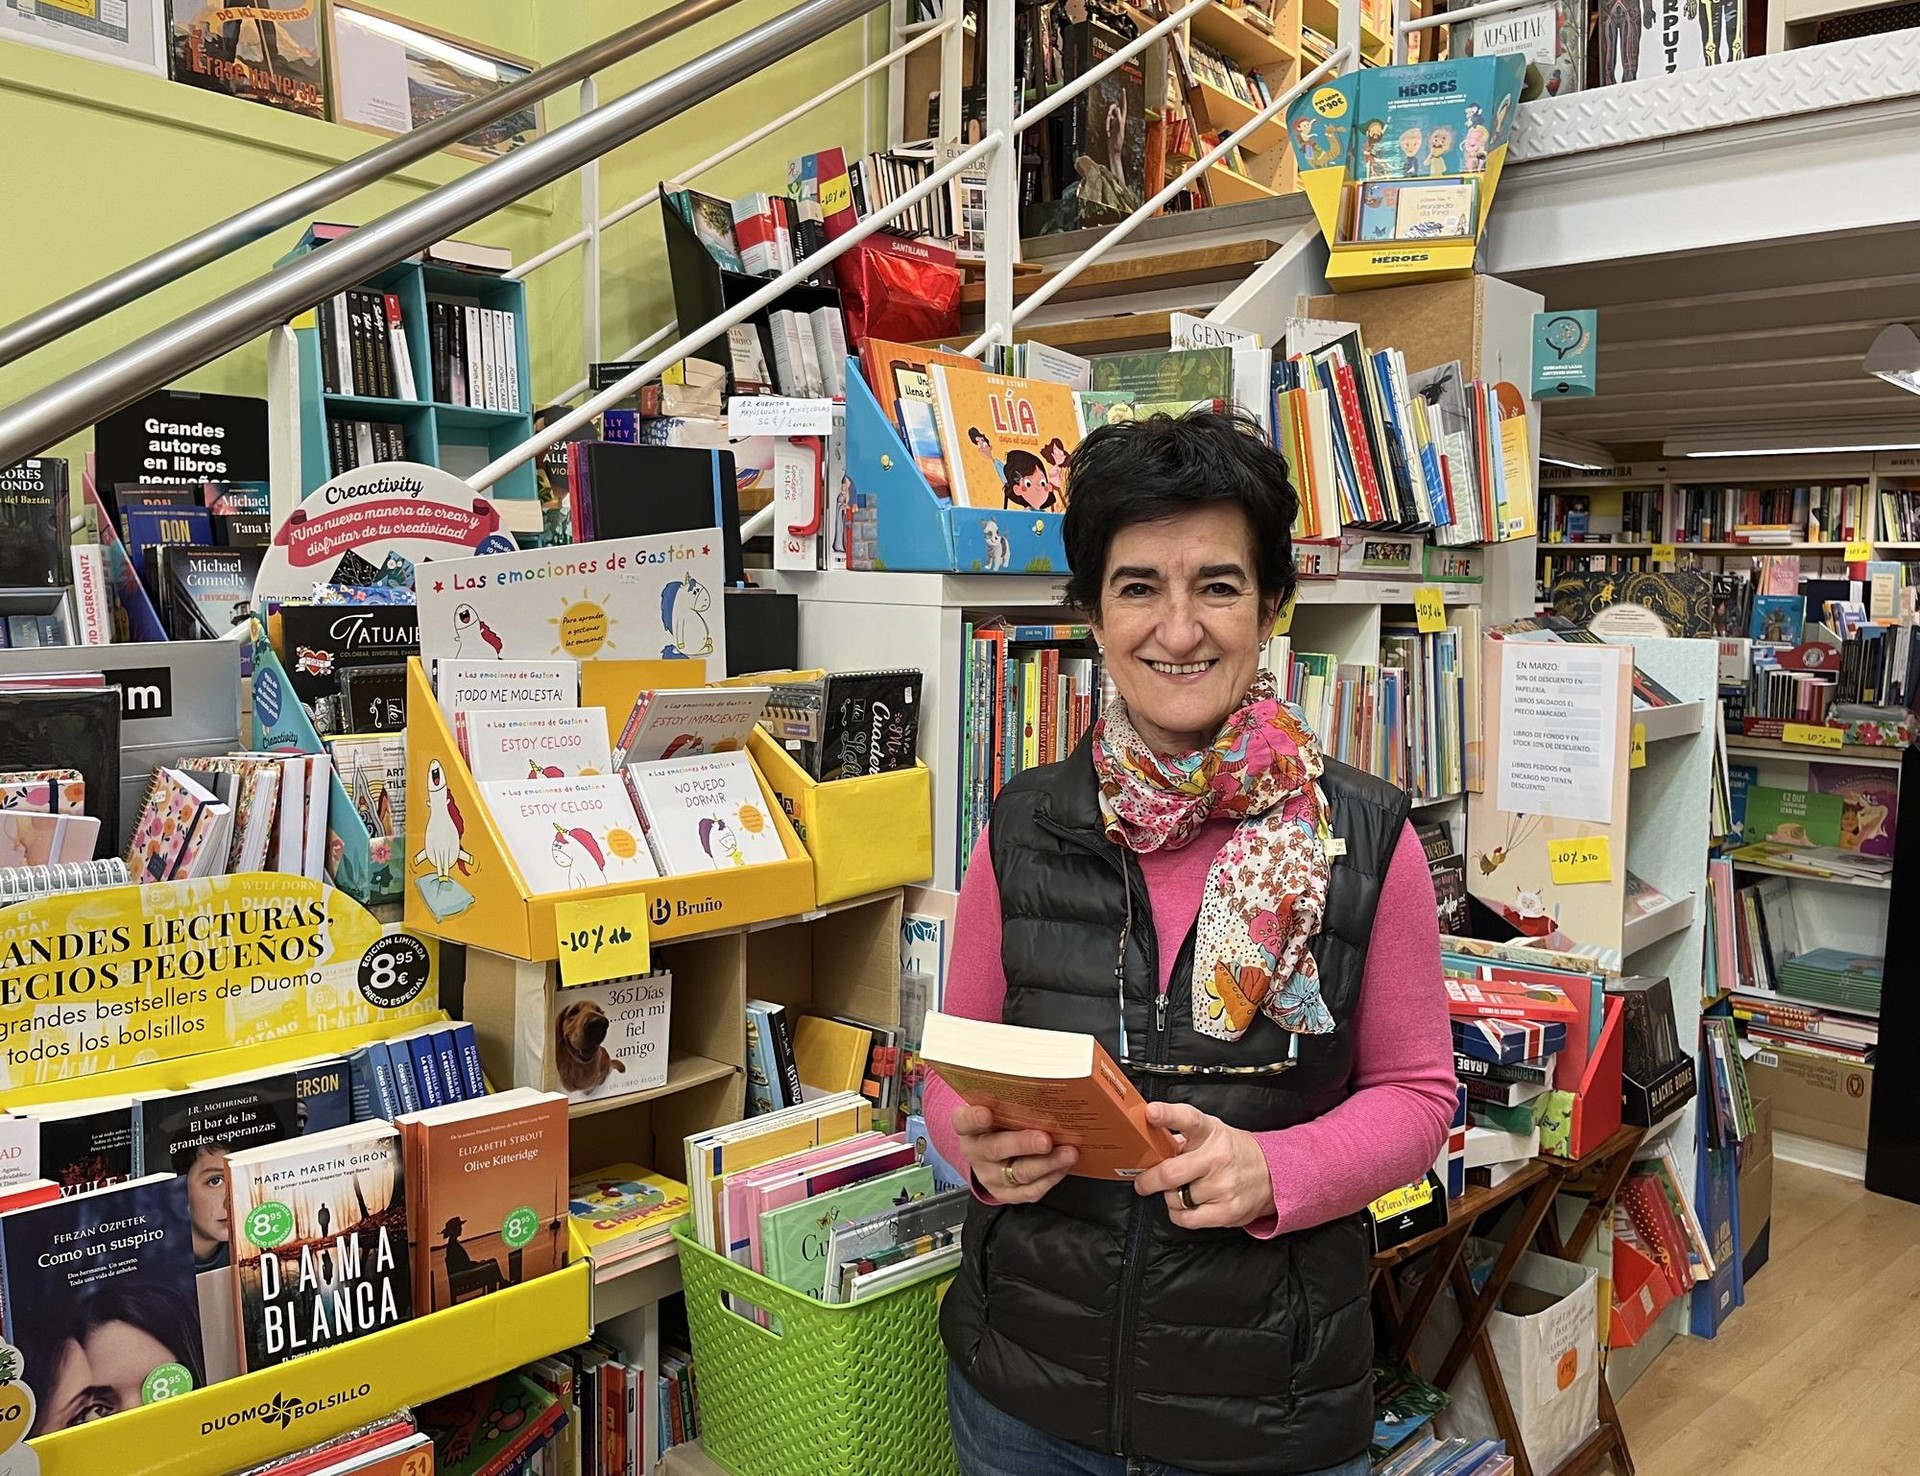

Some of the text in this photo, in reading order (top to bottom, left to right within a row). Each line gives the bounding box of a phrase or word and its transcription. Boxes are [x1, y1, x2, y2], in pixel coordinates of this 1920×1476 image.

[1399, 80, 1457, 98] HÉROES
[891, 241, 929, 258] SANTILLANA
[1371, 253, 1429, 265] HÉROES
[988, 388, 1040, 437] LÍA
[145, 418, 225, 438] Grandes
[149, 439, 221, 455] autores
[144, 456, 227, 473] en libros
[325, 476, 424, 505] Creactivity
[221, 495, 269, 507] Michael
[325, 513, 363, 531] nueva
[364, 505, 415, 521] manera
[416, 504, 433, 517] de
[434, 508, 468, 524] crear
[469, 515, 480, 530] y
[160, 519, 192, 543] DON
[307, 522, 467, 558] disfrutar de tu creatividad!
[189, 559, 242, 573] Michael
[453, 543, 696, 592] Las emociones de Gastón
[186, 574, 247, 589] Connelly
[562, 611, 604, 625] Para aprender
[464, 669, 556, 680] Las emociones de Gastón
[1516, 661, 1560, 672] EN MARZO:
[1538, 676, 1574, 684] DESCUENTO
[490, 688, 509, 702] ME
[512, 688, 563, 702] MOLESTA!
[1536, 698, 1567, 707] SALDADOS
[1514, 708, 1535, 716] PRECIO
[493, 717, 584, 728] Las emociones de Gastón
[262, 730, 299, 749] Creactivity
[501, 734, 582, 753] ESTOY CELOSO
[1513, 730, 1533, 738] LIBROS
[1543, 733, 1565, 741] FONDO
[1554, 743, 1591, 752] DESCUENTO.
[1512, 761, 1532, 770] LIBROS
[1532, 763, 1559, 772] PEDIDOS
[675, 777, 726, 795] NO PUEDO
[1511, 773, 1539, 781] ENCARGO
[1551, 776, 1572, 785] TIENEN
[1511, 782, 1545, 791] DESCUENTO.
[520, 798, 603, 818] ESTOY CELOSO
[685, 792, 727, 809] DORMIR
[676, 896, 723, 918] Bruño
[142, 901, 335, 949] LECTURAS,
[131, 933, 325, 985] PEQUEÑOS
[361, 936, 426, 968] EDICIÓN LIMITADA
[362, 976, 426, 1006] PRECIO ESPECIAL
[607, 985, 665, 1007] 365 Días
[0, 971, 322, 1042] grandes bestsellers de Duomo
[648, 1000, 665, 1017] mi
[626, 1020, 645, 1038] fiel
[7, 1016, 205, 1066] todos los bolsillos
[615, 1041, 655, 1059] amigo
[1457, 1057, 1489, 1076] ÁRABE
[420, 1055, 436, 1105] LA RETORNADA
[1651, 1066, 1693, 1108] BLACKIE BOOKS
[204, 1094, 259, 1113] MOEHRINGER
[190, 1110, 257, 1133] El bar de las
[169, 1121, 277, 1154] grandes esperanzas
[458, 1130, 545, 1158] ELIZABETH STROUT
[253, 1150, 389, 1187] MARTA MARTÍN GIRÓN
[464, 1149, 539, 1174] Olive Kitteridge
[53, 1214, 147, 1245] FERZAN OZPETEK
[37, 1227, 165, 1269] Como un suspiro
[264, 1276, 399, 1355] BLANCA
[200, 1383, 373, 1437] DUOMO BOLSILLO
[405, 1458, 427, 1476] 31
